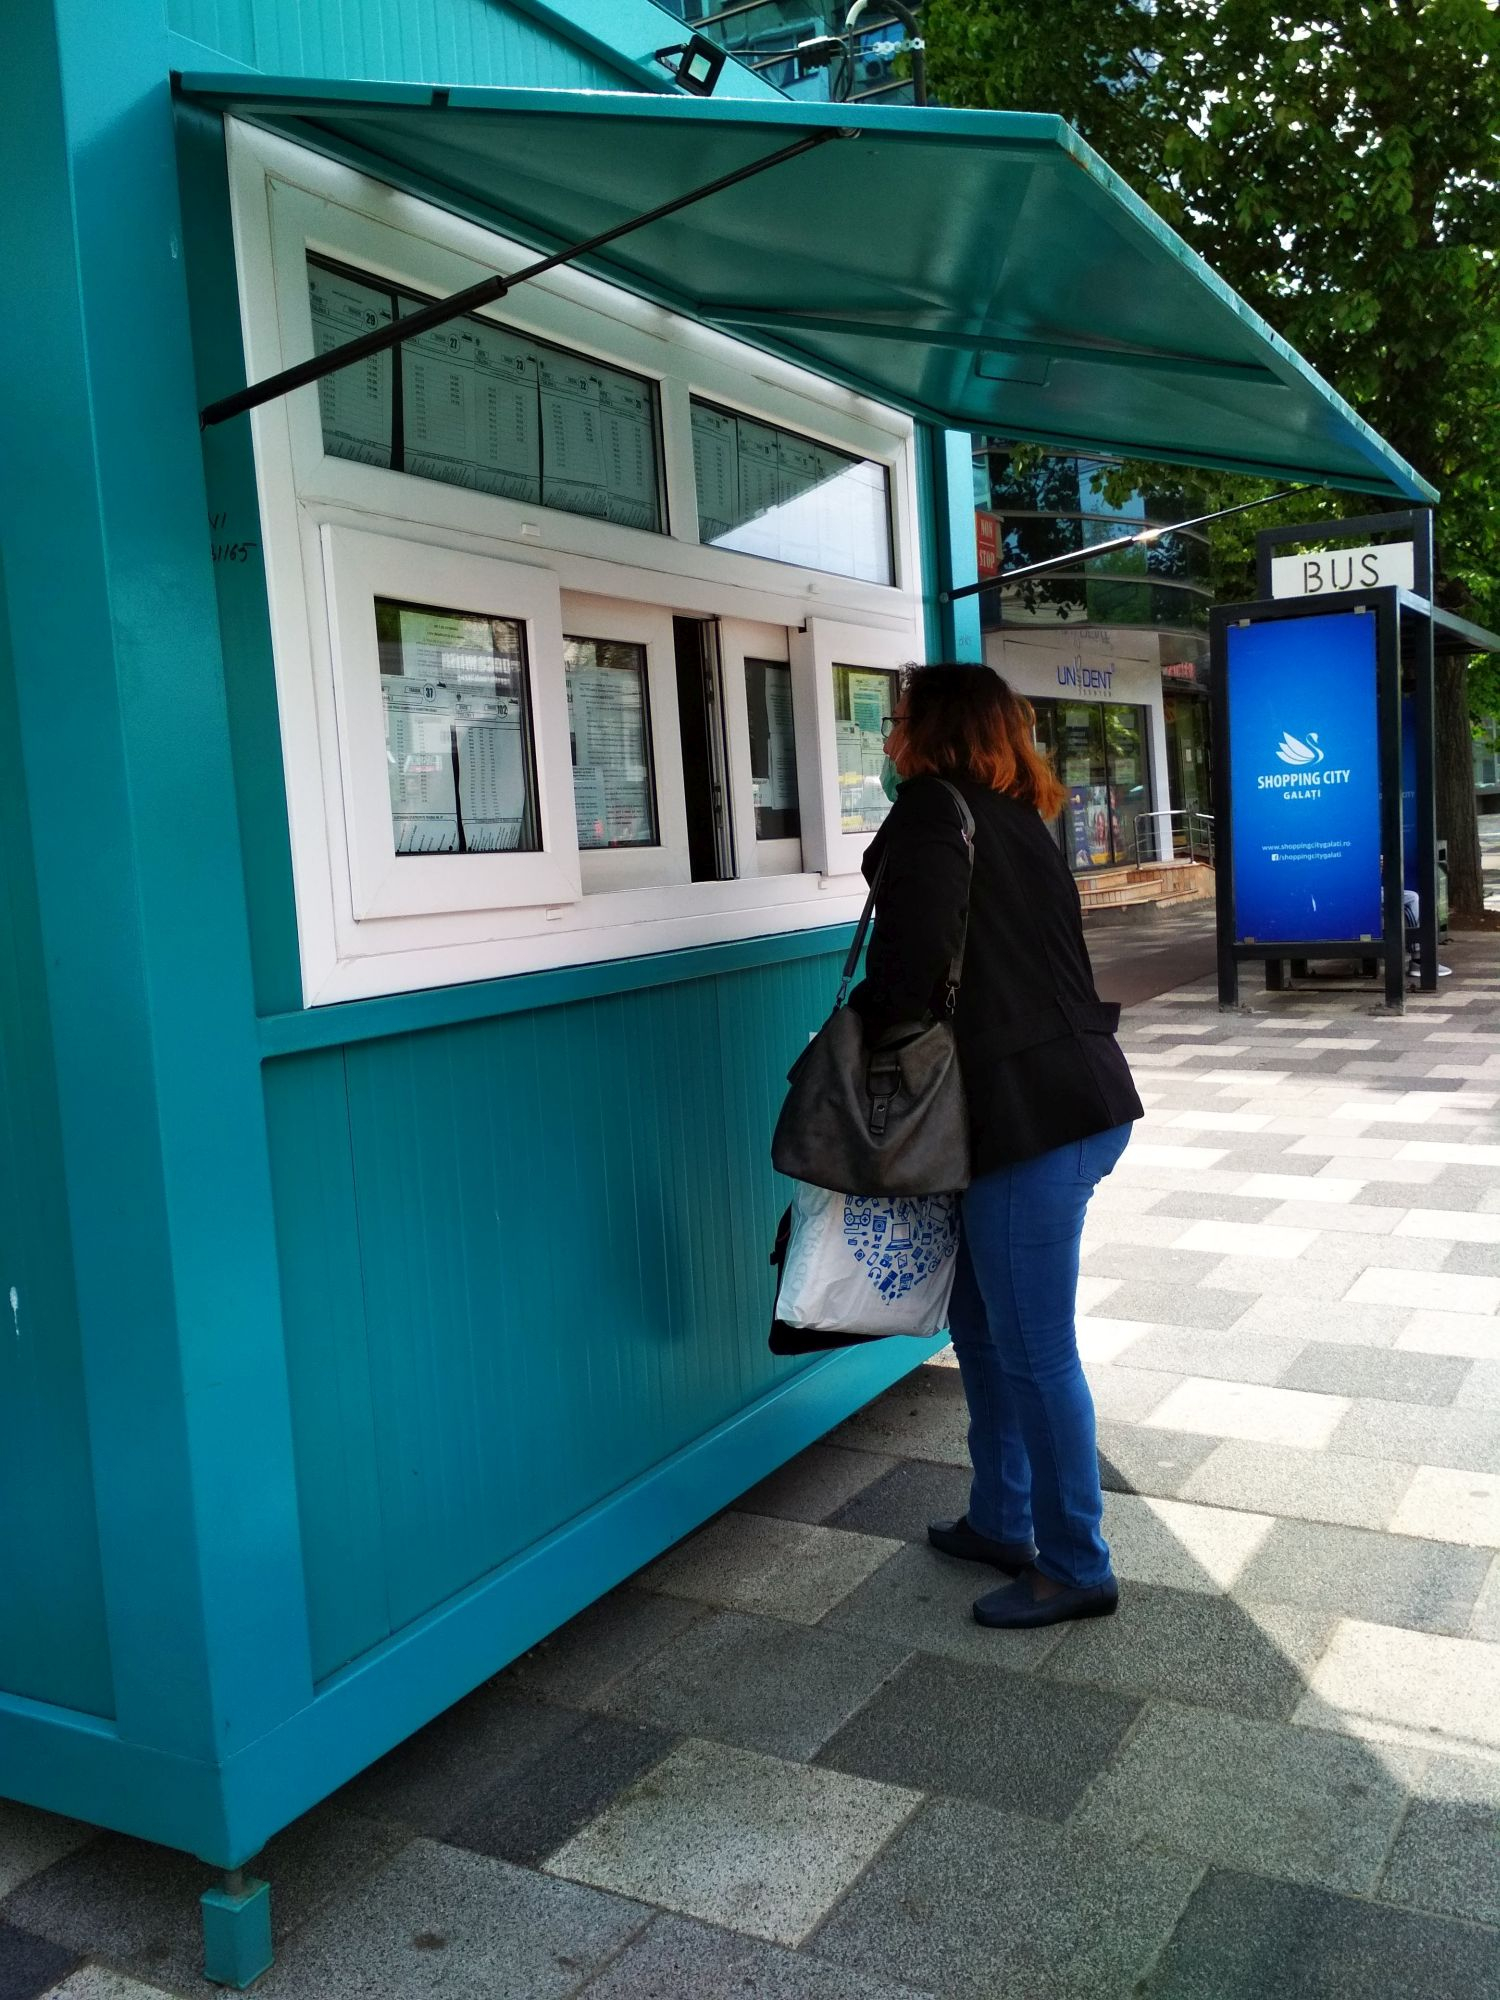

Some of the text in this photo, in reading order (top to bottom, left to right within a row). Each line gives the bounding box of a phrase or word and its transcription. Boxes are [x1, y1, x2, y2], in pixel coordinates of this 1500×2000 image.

[980, 519, 993, 536] NON
[979, 549, 995, 569] STOP
[1303, 553, 1380, 593] BUS
[425, 687, 434, 699] 37
[1257, 769, 1351, 790] SHOPPING CITY
[1261, 840, 1351, 851] www.shoppingcitygalati.ro
